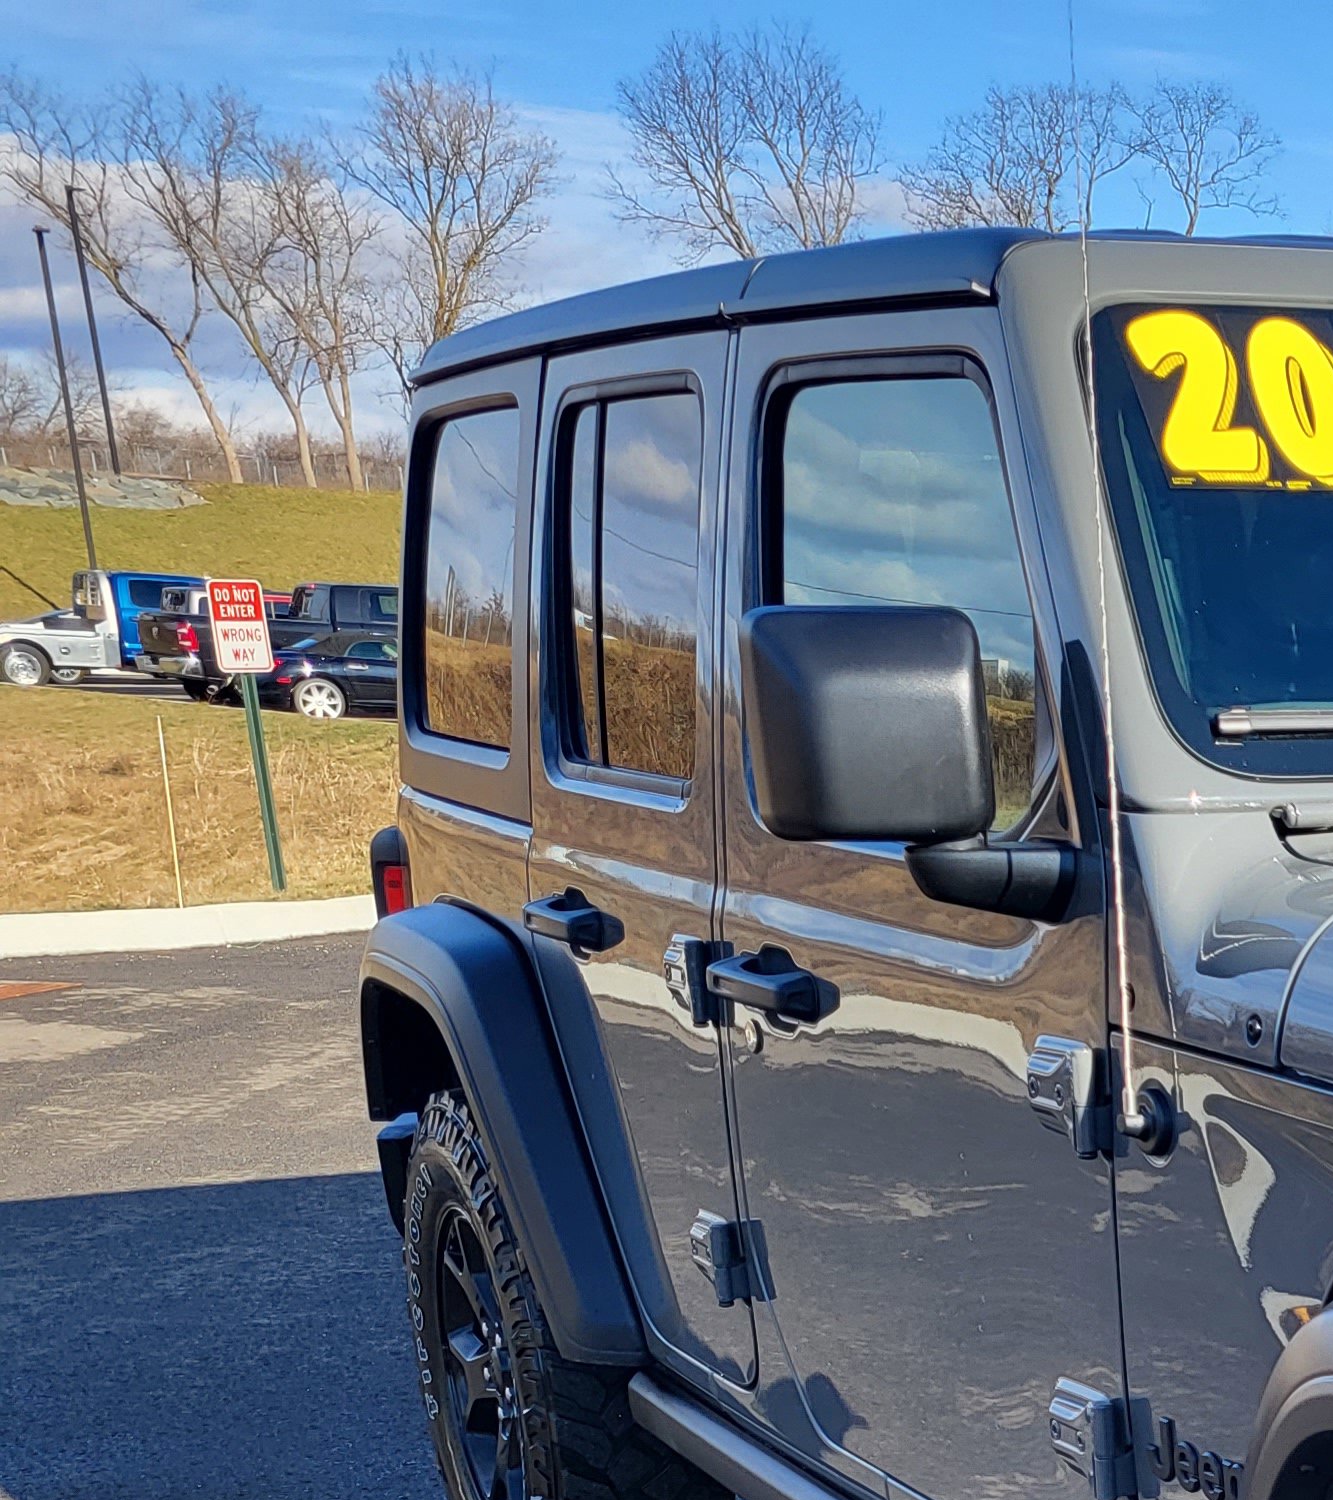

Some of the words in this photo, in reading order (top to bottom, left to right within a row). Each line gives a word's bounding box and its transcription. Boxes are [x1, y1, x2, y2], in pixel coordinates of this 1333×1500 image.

[214, 588, 230, 602] DO
[233, 588, 255, 602] NOT
[220, 604, 255, 618] ENTER
[221, 628, 262, 642] WRONG
[232, 648, 255, 662] WAY
